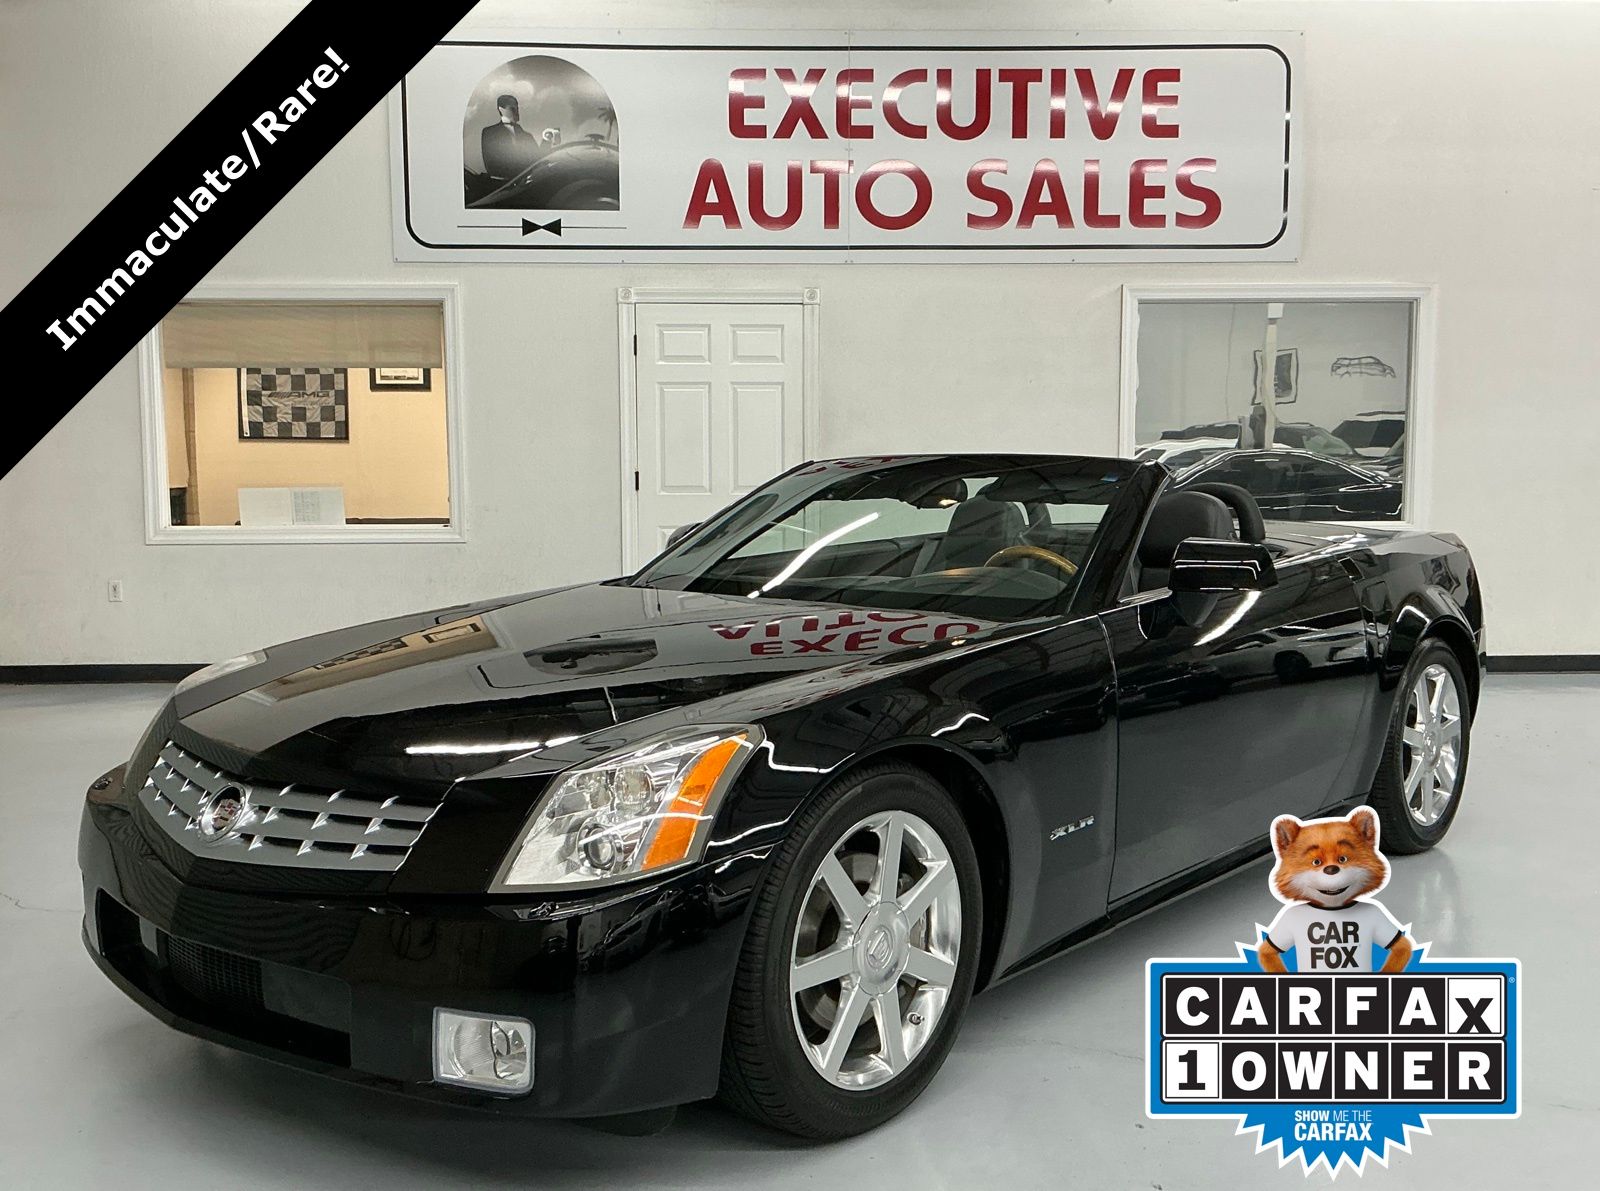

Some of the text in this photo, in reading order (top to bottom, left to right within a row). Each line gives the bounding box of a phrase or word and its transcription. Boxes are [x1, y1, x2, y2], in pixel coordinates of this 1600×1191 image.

[727, 67, 1183, 140] EXECUTIVE
[684, 157, 1223, 230] AUTO SALES
[286, 390, 331, 399] AMG
